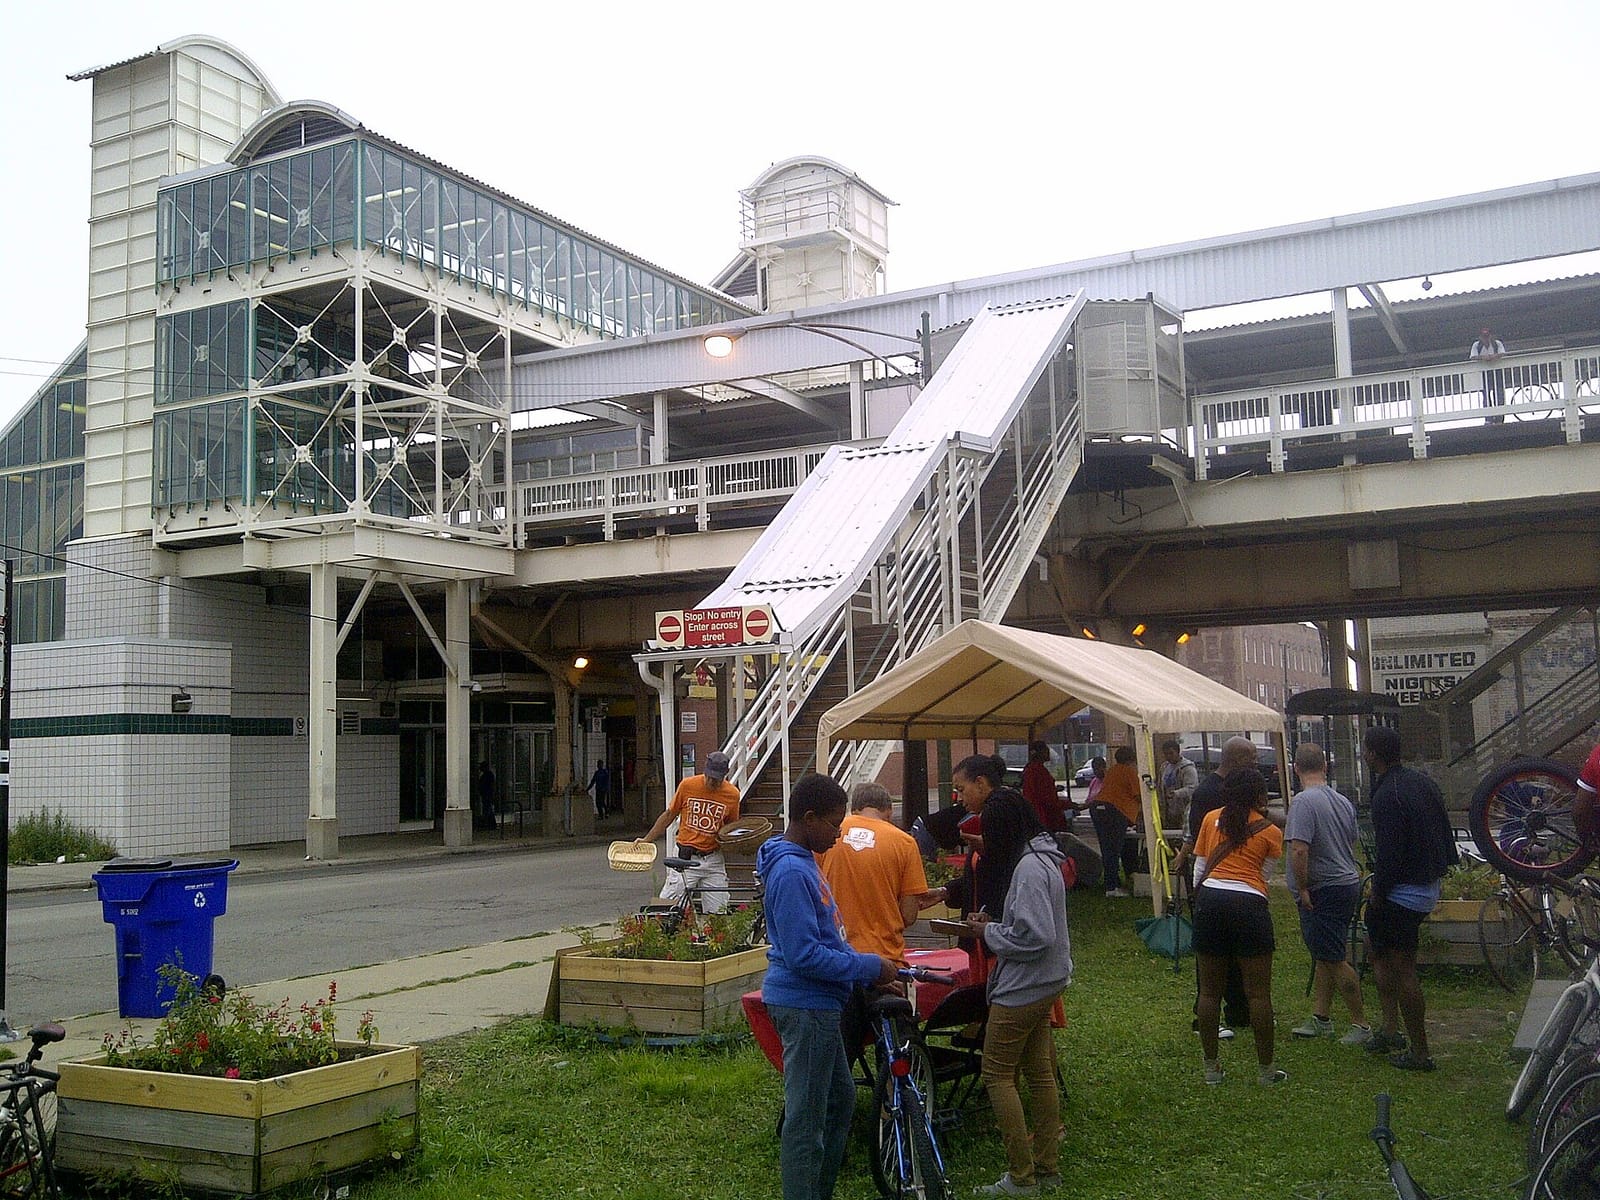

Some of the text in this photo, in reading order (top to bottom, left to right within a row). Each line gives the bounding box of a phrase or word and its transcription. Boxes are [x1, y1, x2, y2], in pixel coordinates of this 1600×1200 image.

[684, 610, 742, 622] Stop! No entry
[688, 622, 739, 632] Enter across
[702, 632, 725, 642] street
[693, 801, 724, 819] BIKE
[692, 814, 721, 831] BOX
